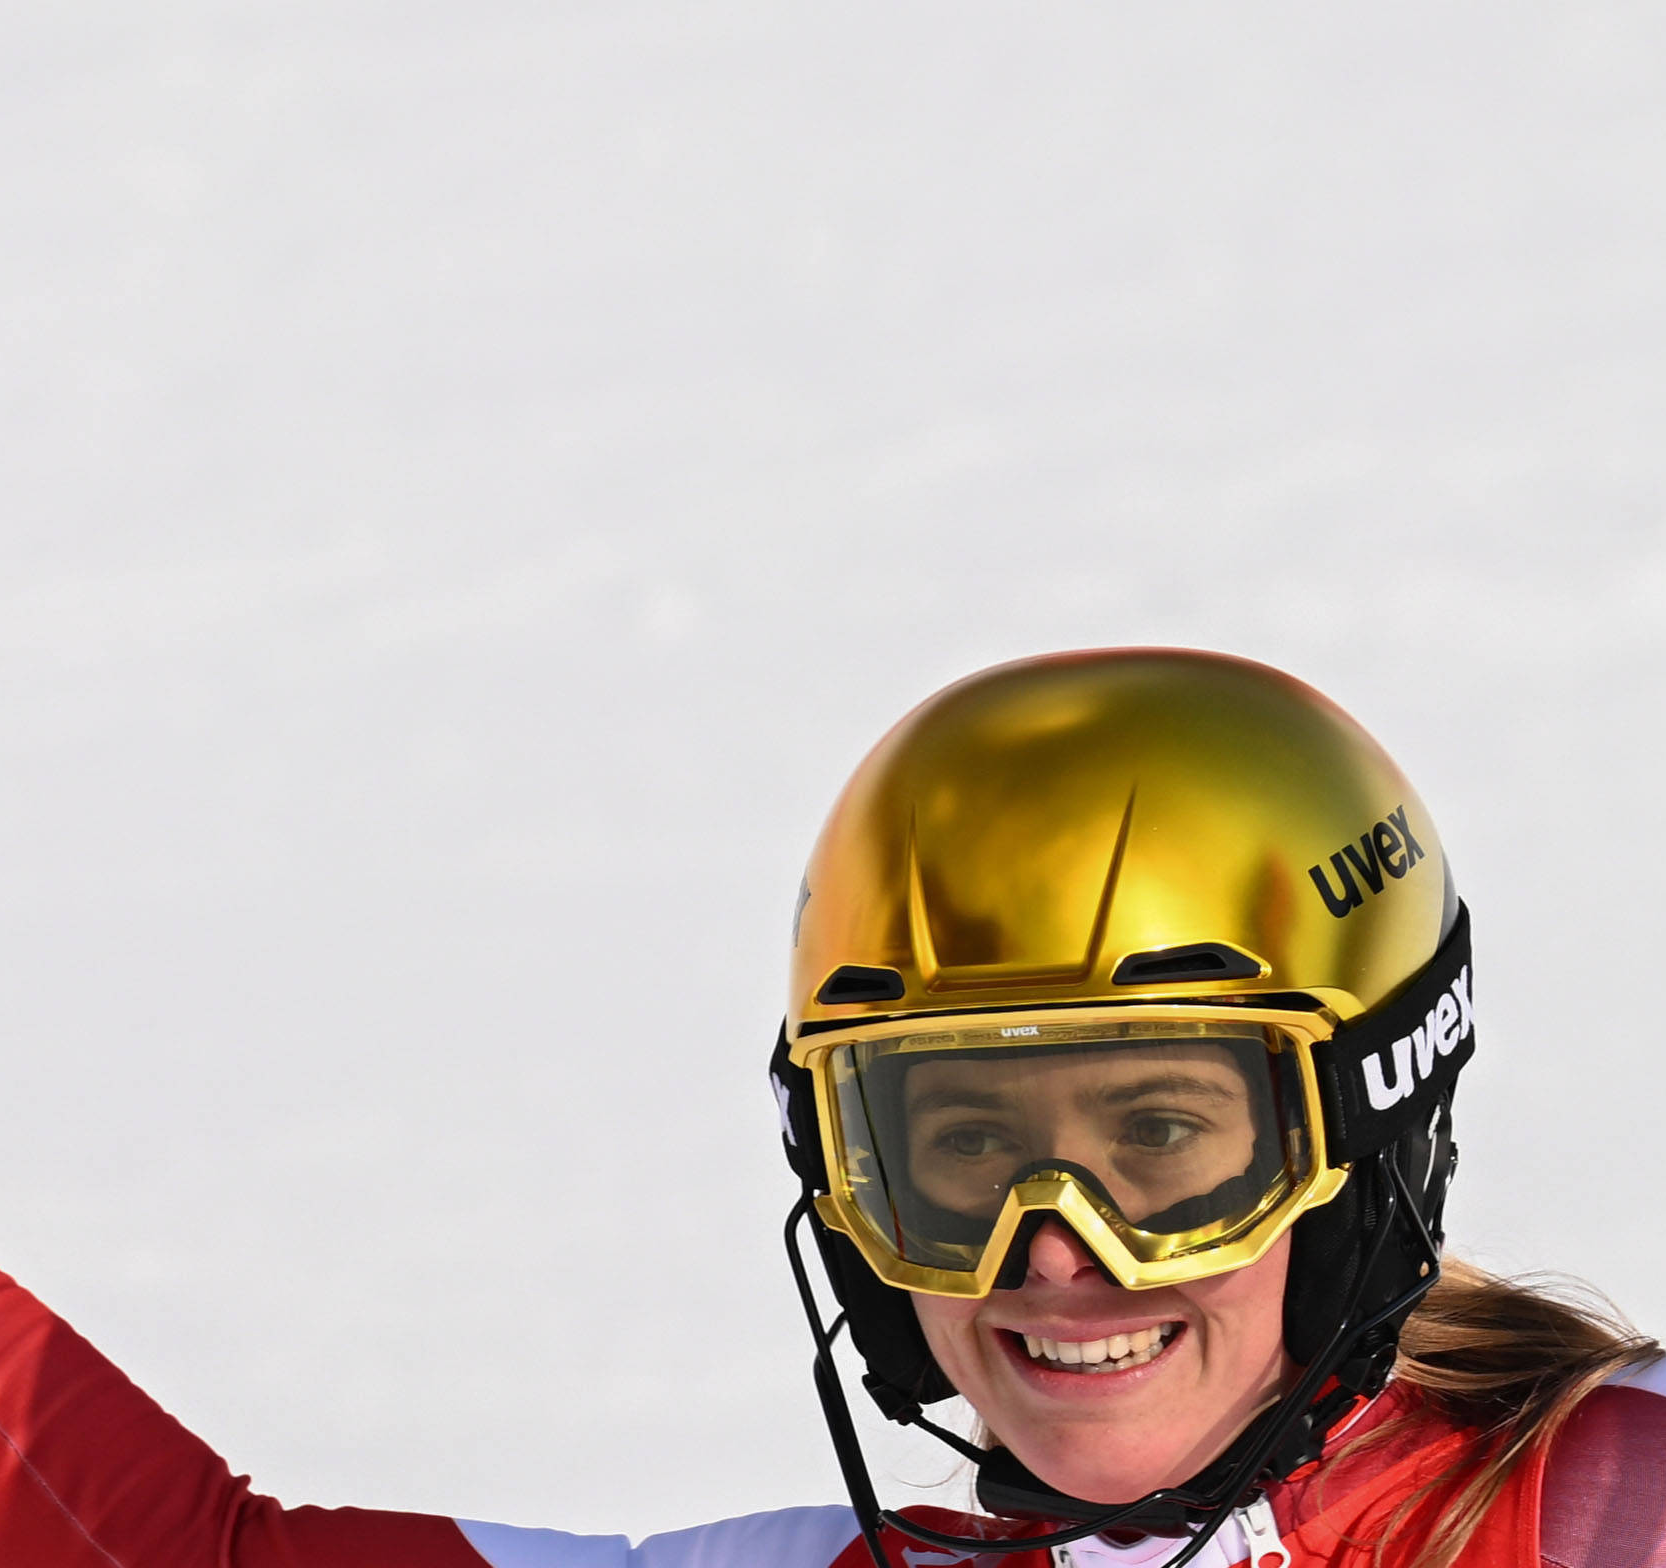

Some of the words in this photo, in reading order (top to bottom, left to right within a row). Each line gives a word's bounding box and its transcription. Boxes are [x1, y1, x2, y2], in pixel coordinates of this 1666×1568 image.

[1308, 804, 1426, 918] uvex
[1000, 1025, 1040, 1038] uvex
[1361, 964, 1476, 1111] uvex
